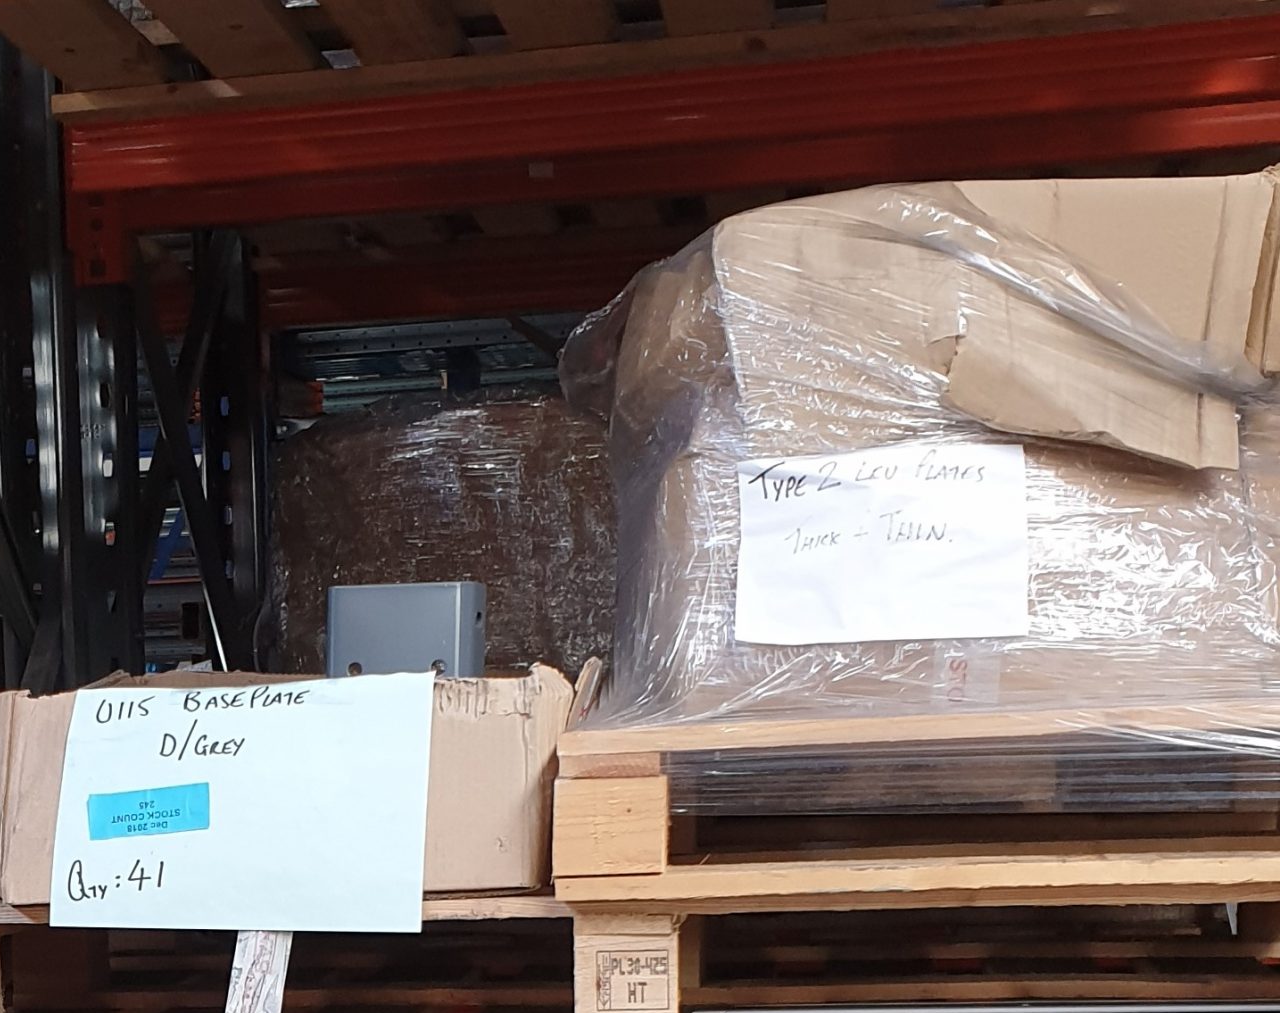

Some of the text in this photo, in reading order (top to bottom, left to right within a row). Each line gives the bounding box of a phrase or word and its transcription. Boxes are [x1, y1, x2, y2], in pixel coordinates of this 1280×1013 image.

[816, 460, 842, 492] 2
[138, 800, 155, 810] 245
[111, 808, 181, 824] STOCK COUNT
[127, 820, 169, 833] Dec 2018
[627, 981, 648, 1004] HT
